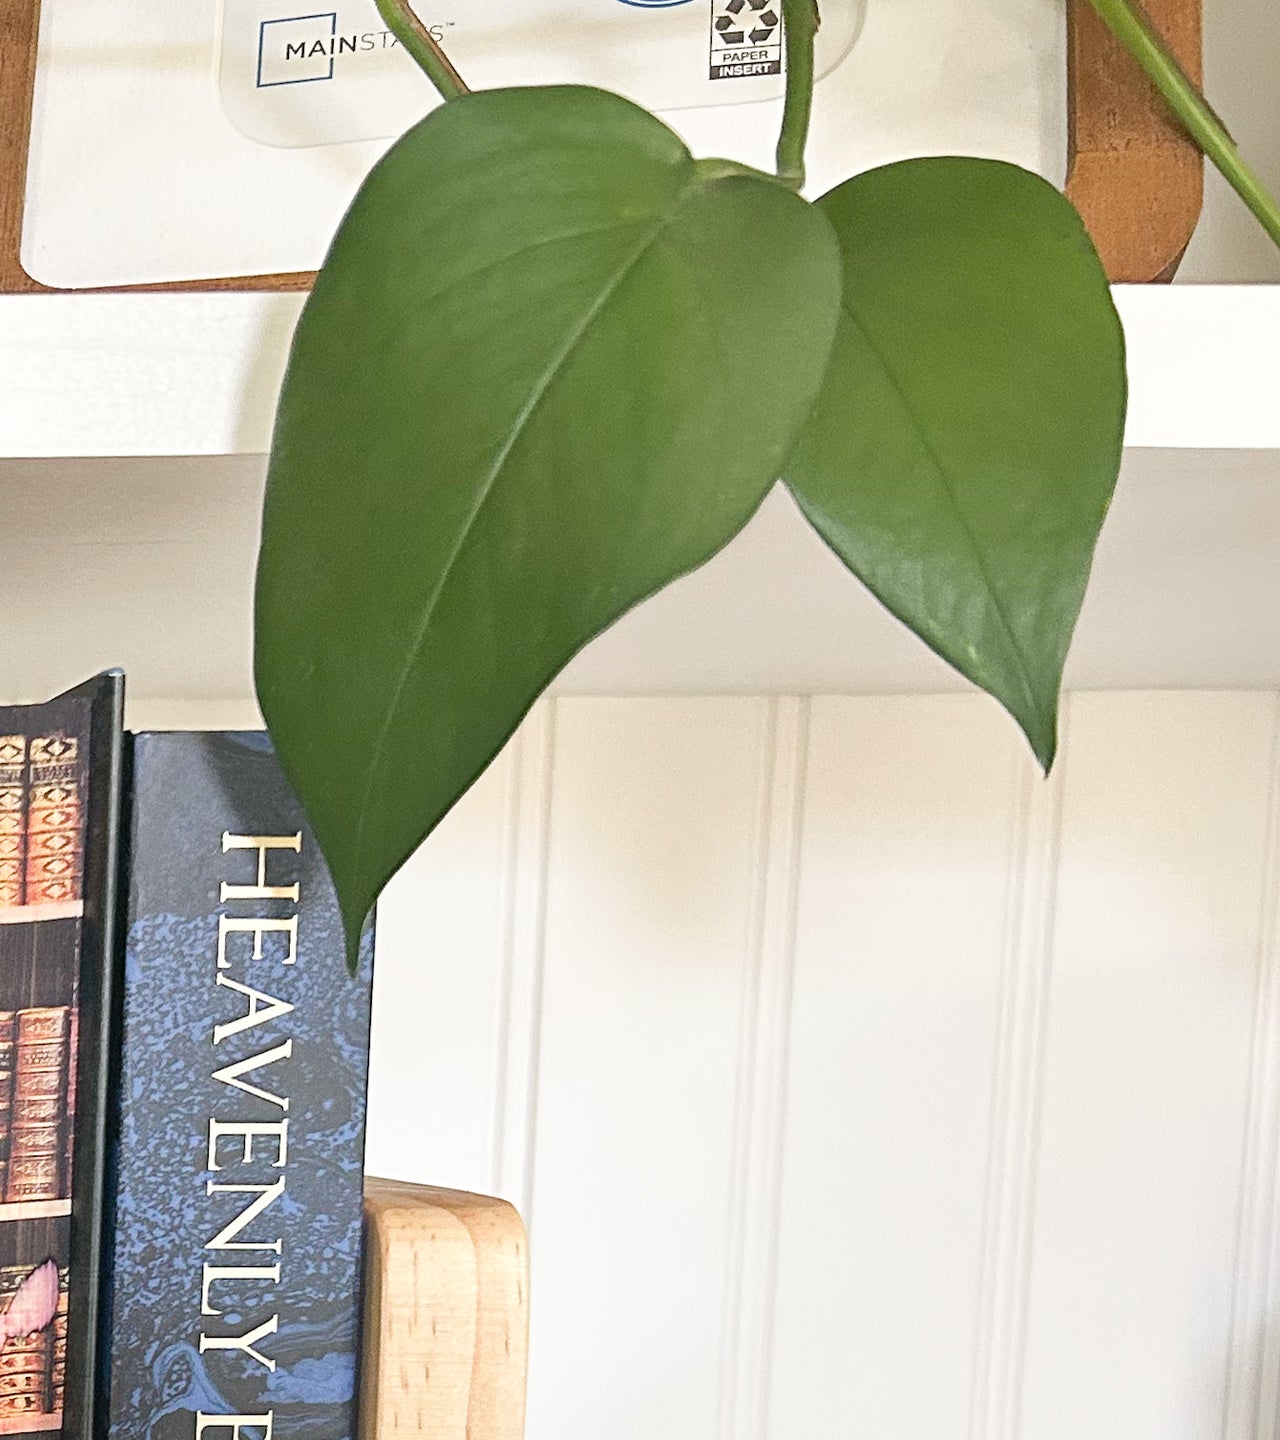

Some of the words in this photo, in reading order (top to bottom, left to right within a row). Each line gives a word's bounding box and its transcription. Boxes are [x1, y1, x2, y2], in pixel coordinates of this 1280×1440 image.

[722, 50, 769, 63] PAPER
[719, 62, 772, 77] INSERT
[198, 829, 304, 1374] HEAVENLY
